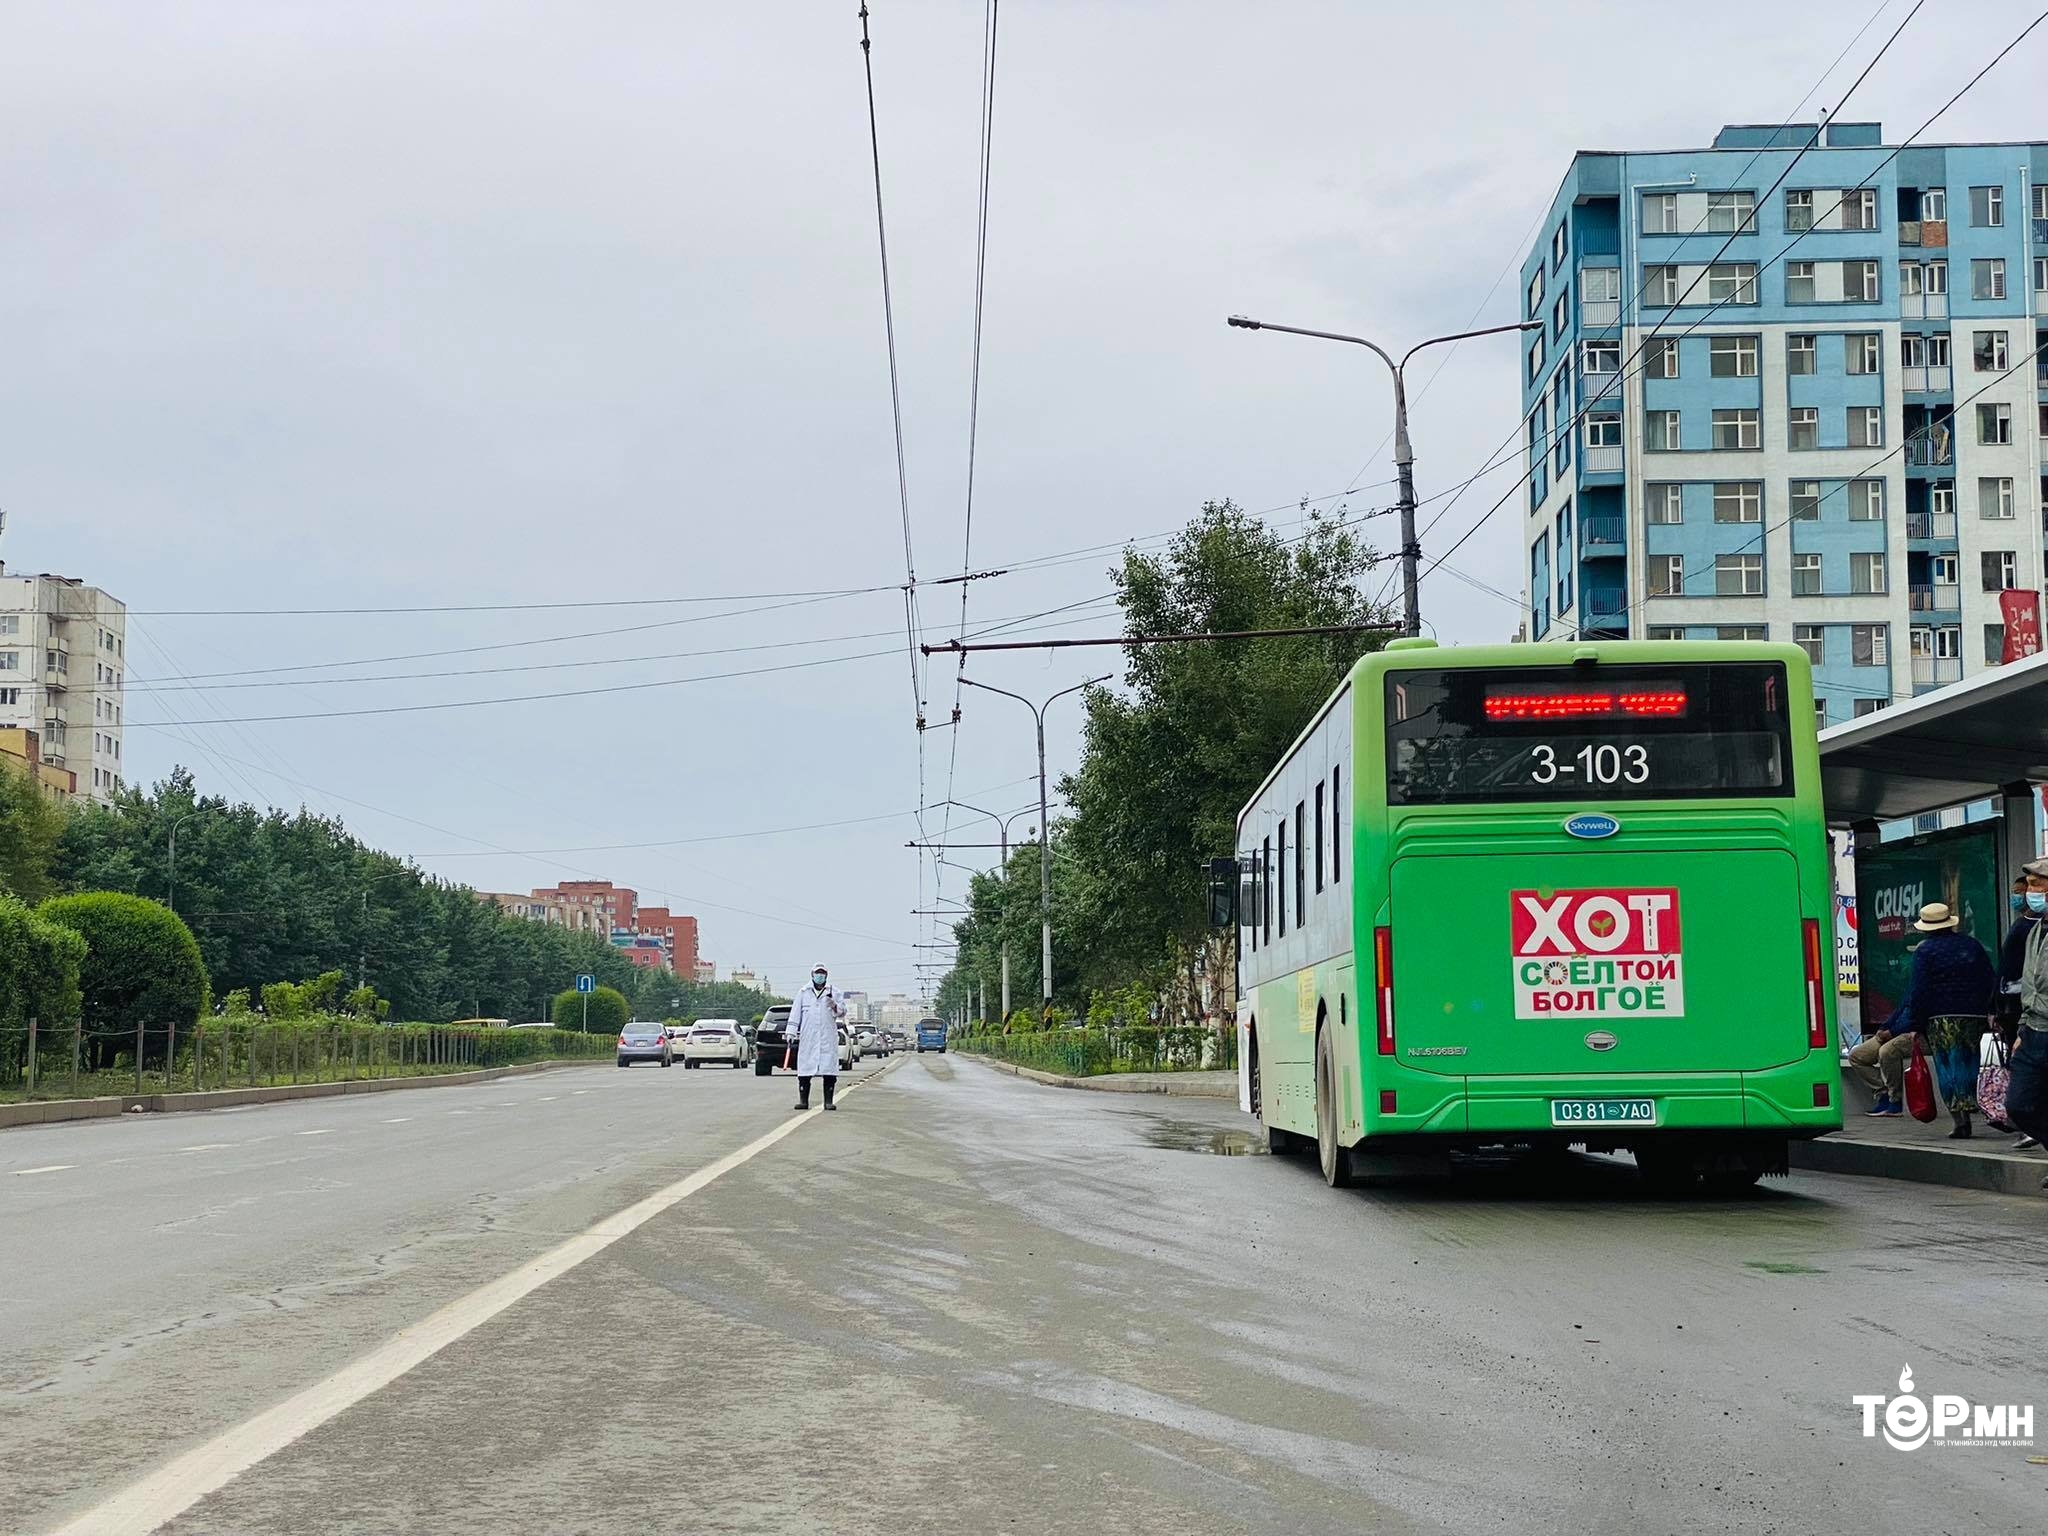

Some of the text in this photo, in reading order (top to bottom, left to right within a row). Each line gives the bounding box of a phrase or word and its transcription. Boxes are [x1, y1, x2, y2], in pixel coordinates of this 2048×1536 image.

[1531, 744, 1650, 784] 3-103
[1570, 821, 1613, 831] Skywell
[1874, 880, 1924, 920] CRUSH
[1518, 894, 1671, 954] ХОТ
[1520, 951, 1676, 986] СОЁЛТОЙ
[1532, 981, 1666, 1012] БОЛГОЁ
